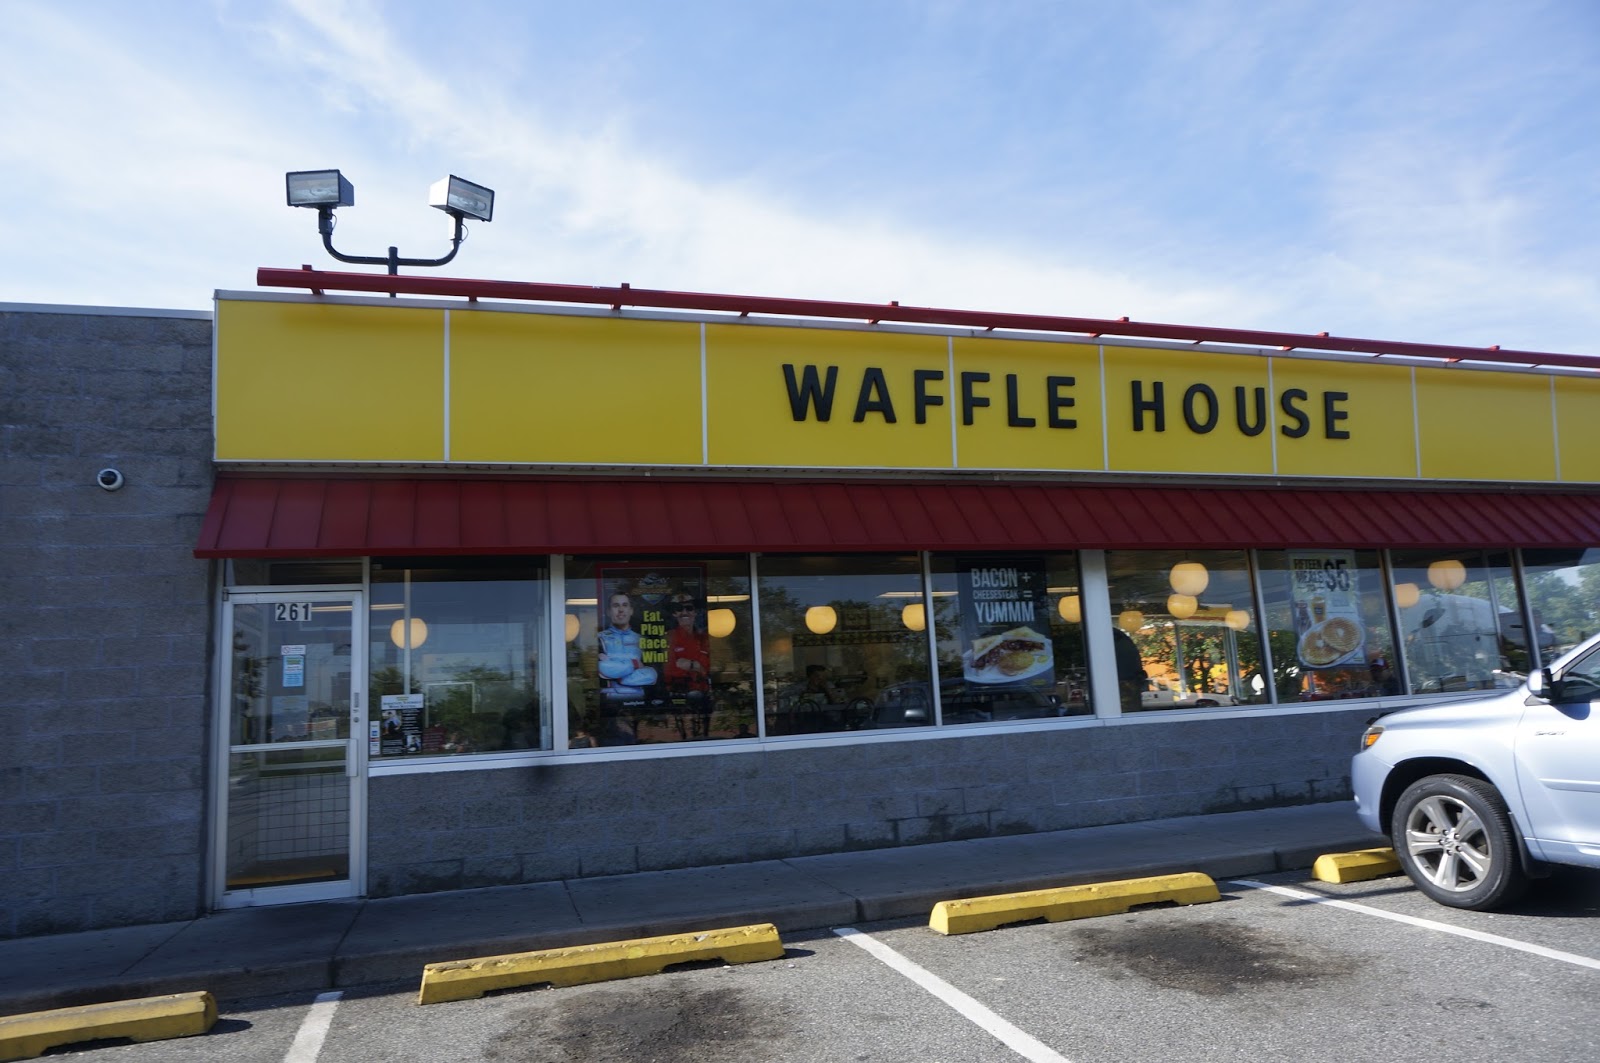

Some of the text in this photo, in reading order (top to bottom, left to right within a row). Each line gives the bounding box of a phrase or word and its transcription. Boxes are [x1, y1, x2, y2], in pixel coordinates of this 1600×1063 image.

[782, 364, 1350, 439] WAFFLE HOUSE
[971, 567, 1018, 588] BACON
[1324, 558, 1351, 592] $5
[973, 589, 1019, 600] CHEESESTEAK
[277, 603, 310, 621] 261
[643, 610, 665, 622] Eat.
[974, 601, 1034, 623] YUMMM
[641, 623, 668, 637] Play.
[639, 637, 670, 649] Race.
[642, 651, 668, 663] Win!
